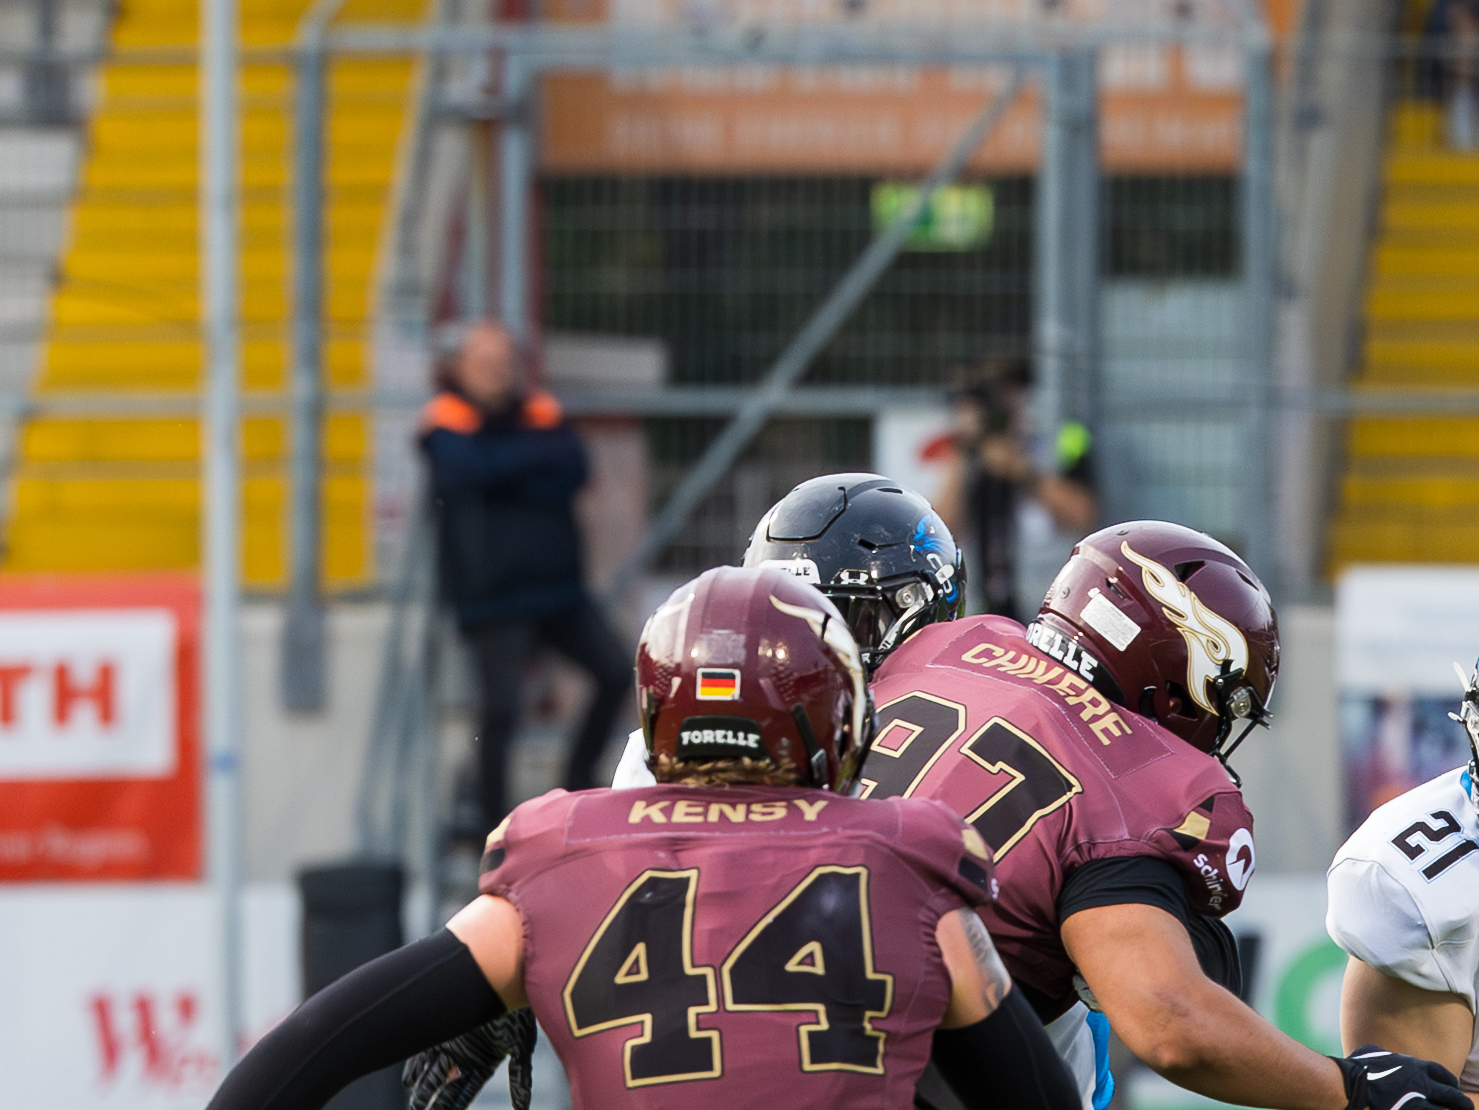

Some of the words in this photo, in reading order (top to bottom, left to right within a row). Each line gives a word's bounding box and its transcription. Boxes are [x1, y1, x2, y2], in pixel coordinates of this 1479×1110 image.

[1025, 622, 1098, 682] ORELLE
[681, 729, 761, 748] FORELLE
[861, 690, 1084, 865] 97
[628, 799, 829, 824] KENSY
[562, 864, 894, 1088] 44
